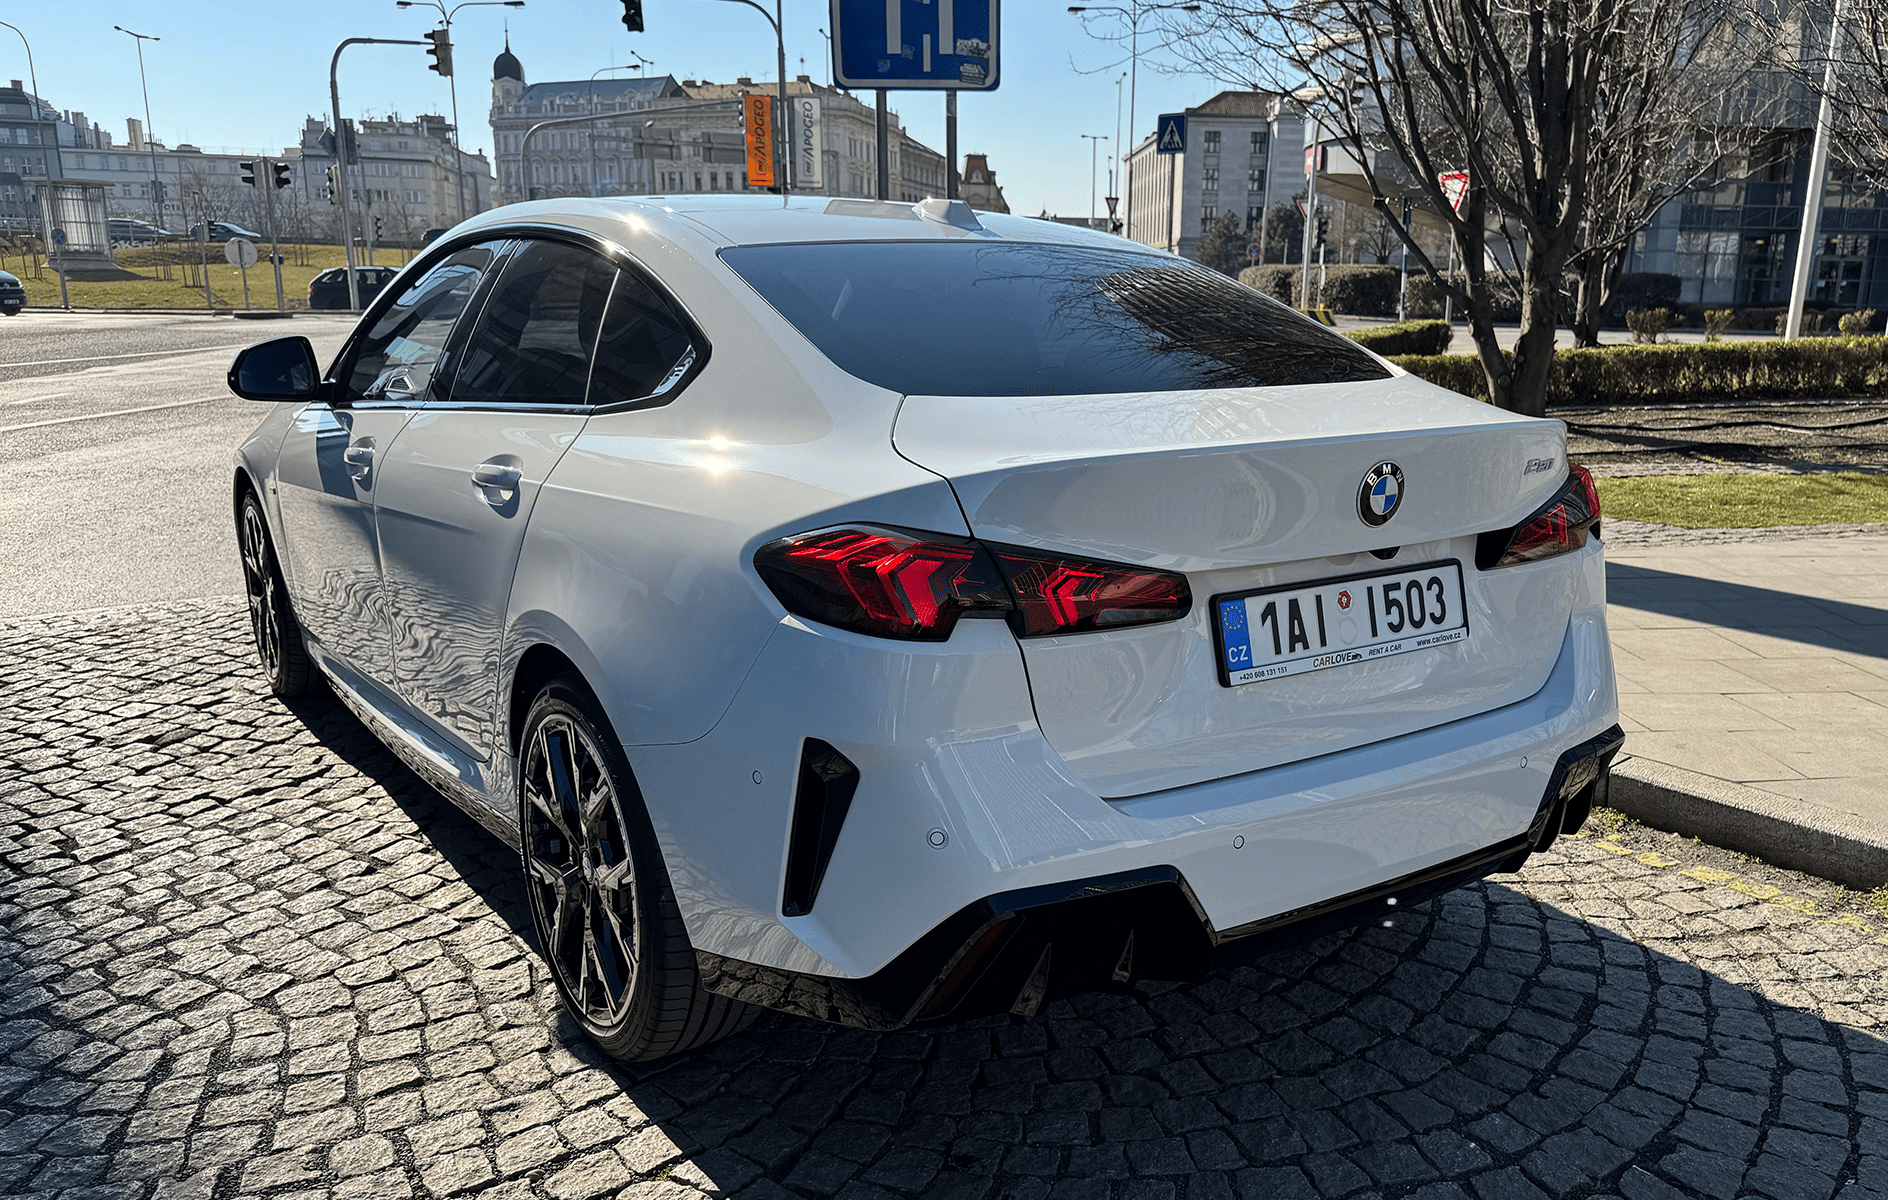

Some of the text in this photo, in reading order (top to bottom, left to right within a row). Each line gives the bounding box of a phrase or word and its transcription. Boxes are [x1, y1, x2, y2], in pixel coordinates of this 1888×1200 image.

[753, 100, 766, 156] APOGEO
[802, 101, 814, 157] APOGEO
[1367, 464, 1405, 486] BMW
[1260, 594, 1328, 655] 1AI
[1416, 632, 1461, 647] www.carlove.cz
[1228, 645, 1249, 663] CZ
[1368, 647, 1385, 656] RENT
[1389, 643, 1402, 652] CAR
[1312, 651, 1352, 668] CARLOVE
[1239, 666, 1288, 681] +420 608 131 151
